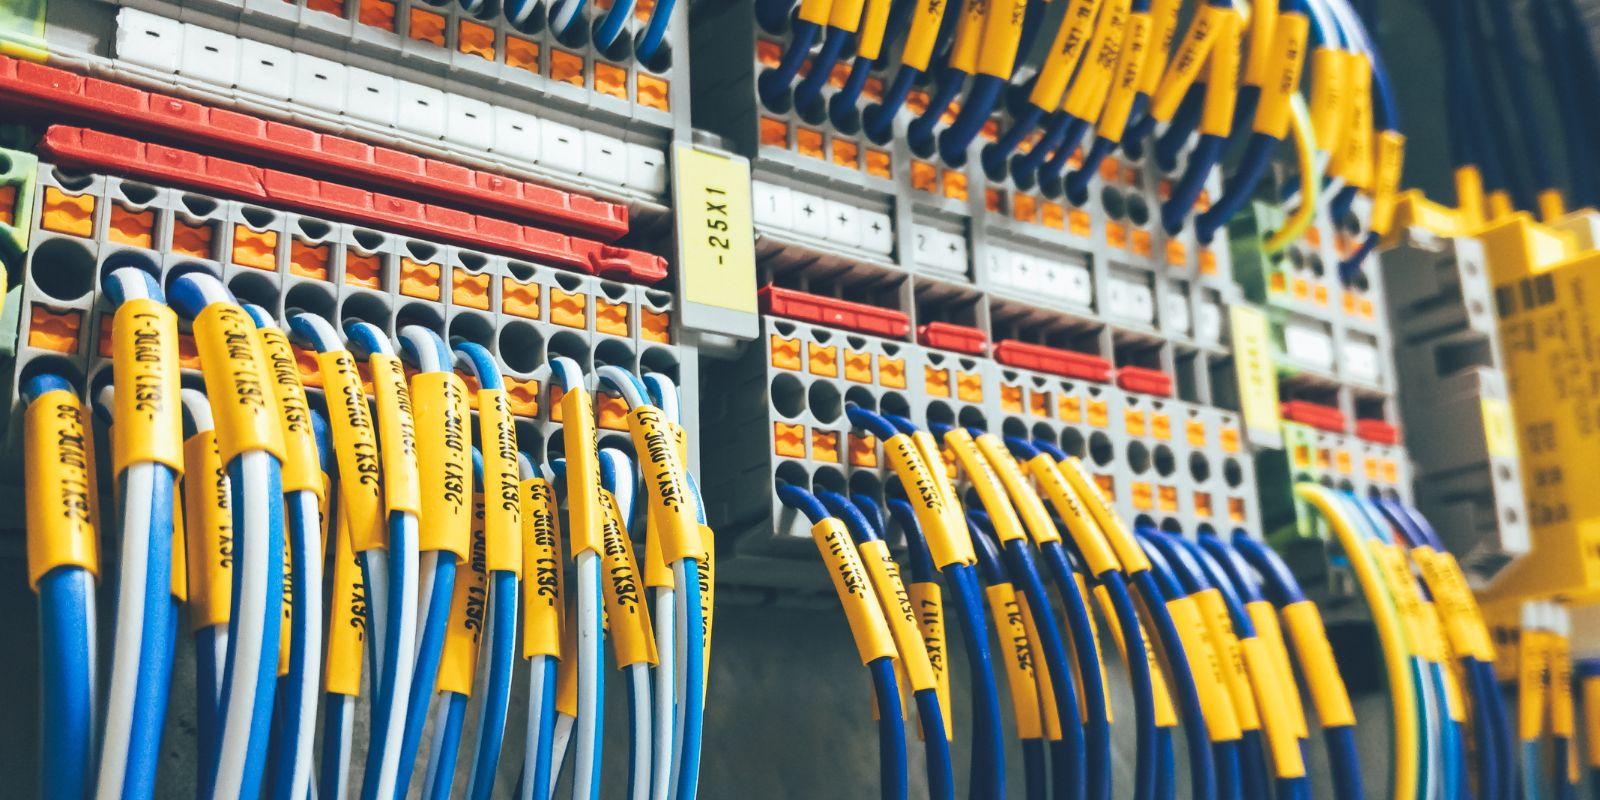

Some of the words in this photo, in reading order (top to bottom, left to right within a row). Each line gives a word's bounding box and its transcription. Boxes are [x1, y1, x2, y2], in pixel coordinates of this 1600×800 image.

[705, 186, 731, 266] -25X1
[769, 195, 776, 213] 1
[803, 204, 814, 218] +
[837, 213, 848, 226] +
[871, 221, 882, 234] +
[916, 234, 926, 251] 2
[947, 242, 958, 254] +
